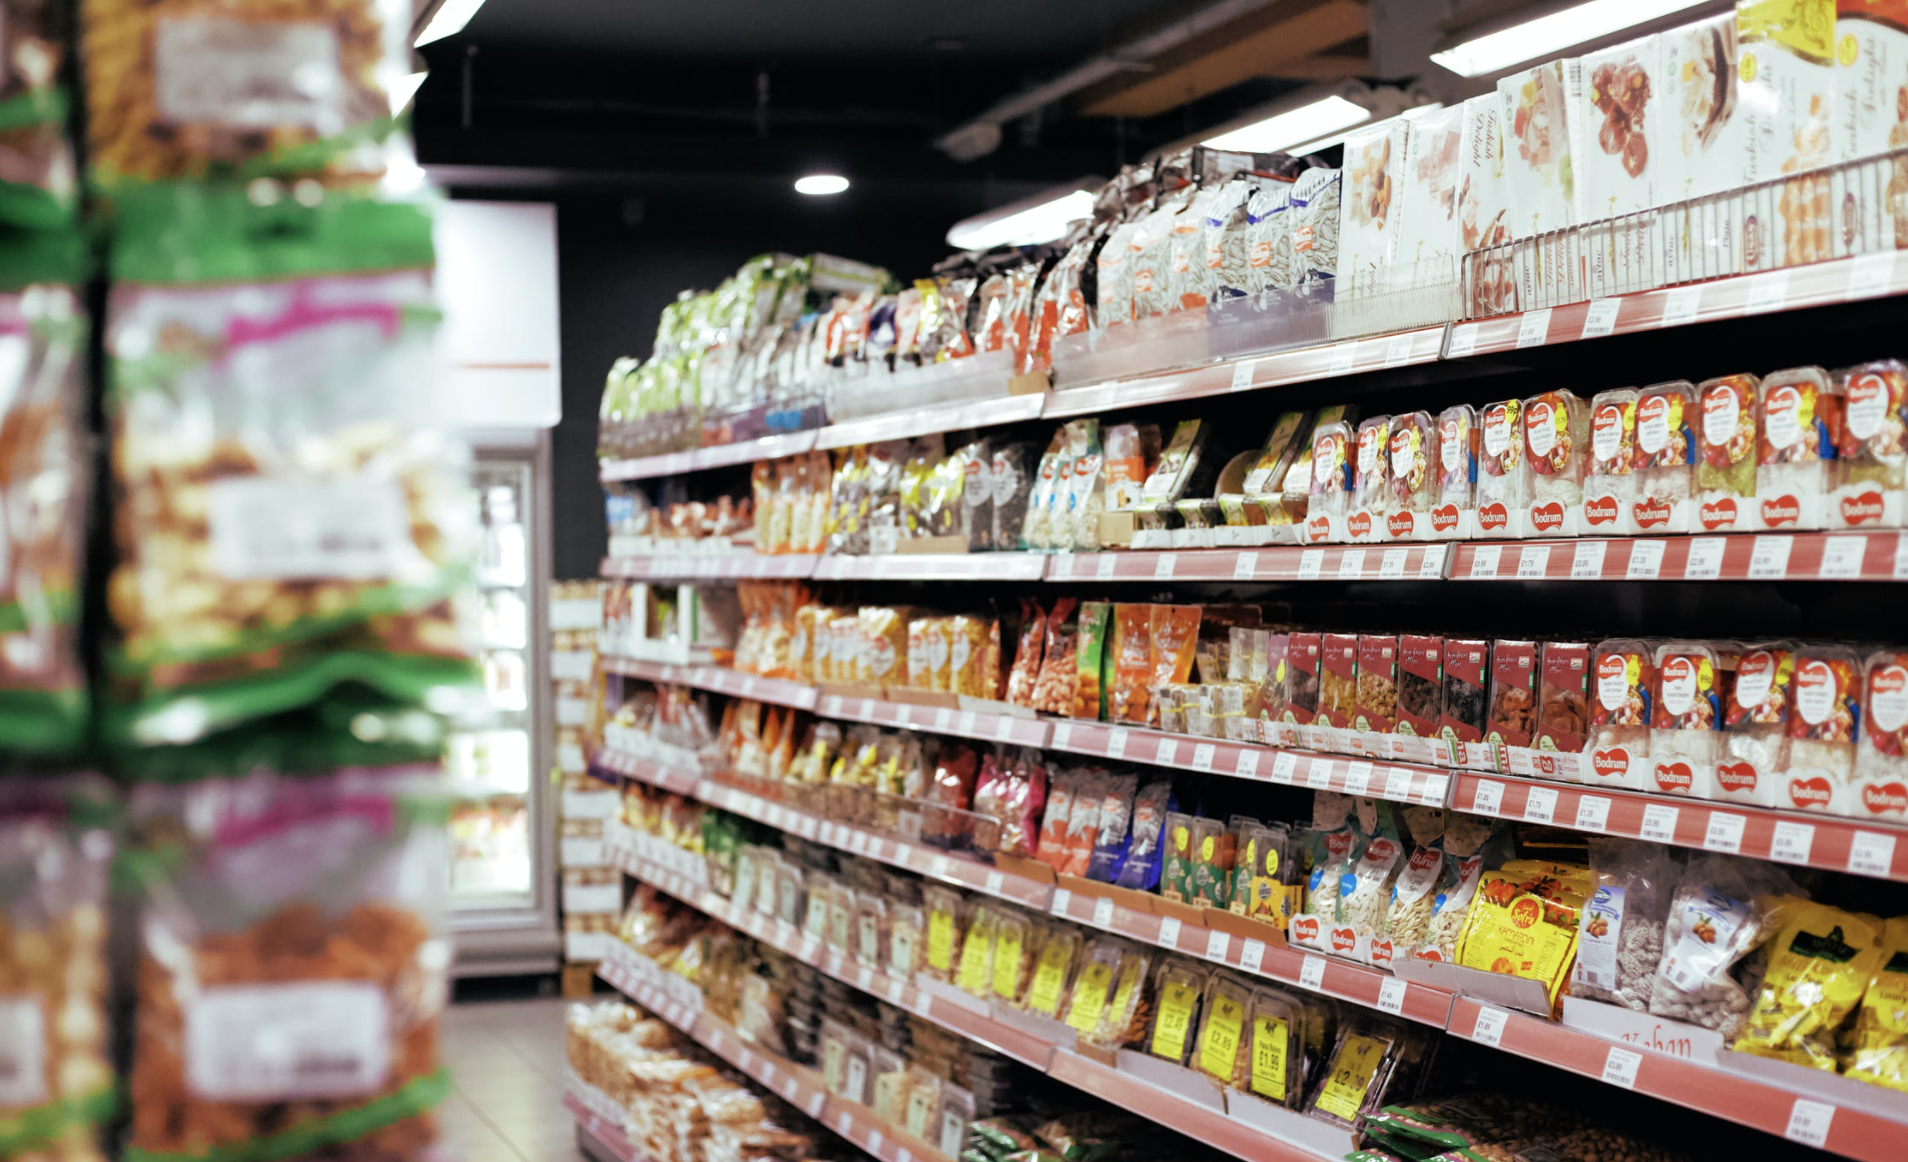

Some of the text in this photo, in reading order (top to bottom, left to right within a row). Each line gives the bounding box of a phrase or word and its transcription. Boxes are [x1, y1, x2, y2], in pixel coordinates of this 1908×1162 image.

[1472, 113, 1485, 167] Delight
[1485, 108, 1497, 160] Turkish
[1506, 406, 1517, 416] 99p
[1528, 413, 1548, 423] Bodrum
[1595, 417, 1616, 425] Bodrum
[1587, 506, 1616, 517] Bodrum
[1636, 506, 1668, 520] Bodrum
[1702, 507, 1735, 521] Bodrum
[1764, 504, 1797, 519] Bodrum
[1843, 501, 1882, 516] Bodrum
[1433, 513, 1457, 525] Bodrum
[1480, 510, 1505, 523] Bodrum
[1534, 511, 1562, 523] Bodrum
[1349, 520, 1370, 531] Bodrum
[1389, 519, 1412, 530] Bodrum
[1599, 664, 1622, 674] Bodrum
[1663, 667, 1687, 677] Bodrum
[1700, 674, 1712, 684] 99p
[1595, 756, 1627, 769] Bodrum
[1657, 769, 1691, 784] Bodrum
[1719, 770, 1755, 785] Bodrum
[1792, 786, 1829, 800] Bodrum
[1866, 789, 1907, 805] Bodrum
[1512, 909, 1534, 924] Sofra
[1332, 933, 1354, 947] Bodrum
